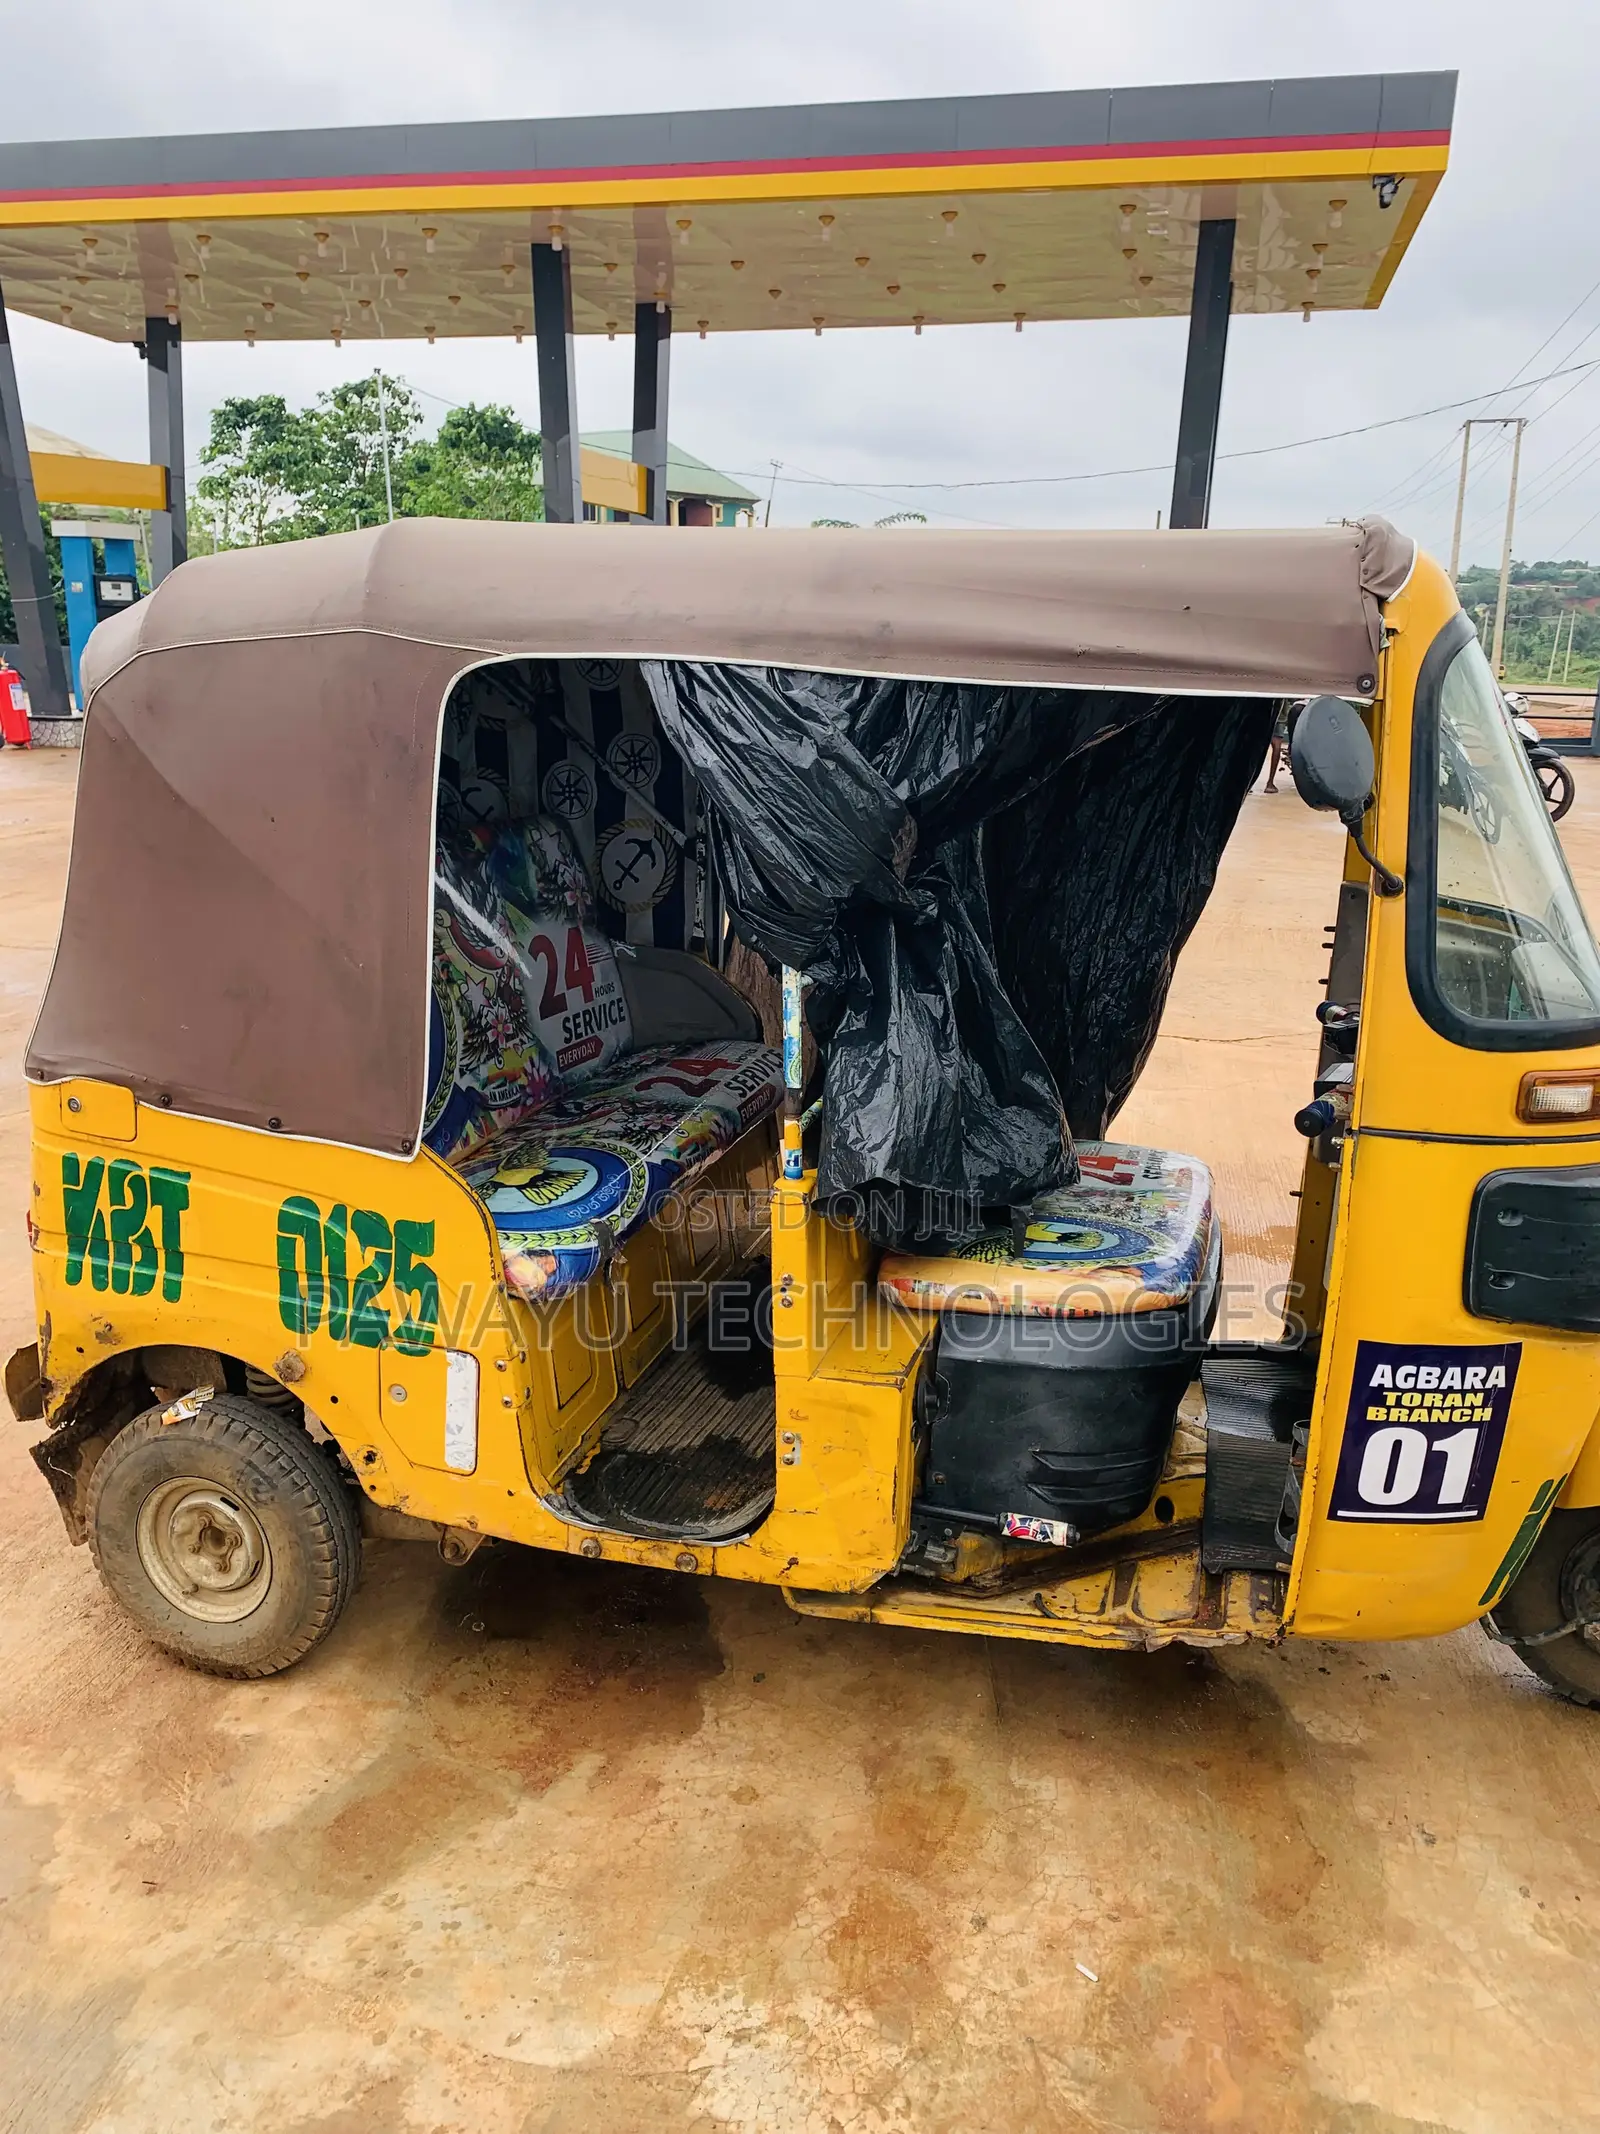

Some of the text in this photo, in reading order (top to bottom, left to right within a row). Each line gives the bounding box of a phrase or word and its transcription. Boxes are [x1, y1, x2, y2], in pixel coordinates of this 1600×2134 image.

[528, 926, 595, 1020] 24
[562, 997, 626, 1044] SERVICE
[558, 1041, 597, 1068] EVERYDAY
[634, 1058, 743, 1098] 24
[740, 1087, 772, 1123] EVERYDAY
[1369, 1364, 1507, 1390] AGBARA
[1366, 1407, 1493, 1423] BRANCH
[1382, 1391, 1484, 1407] TORAN
[1357, 1427, 1480, 1506] 01
